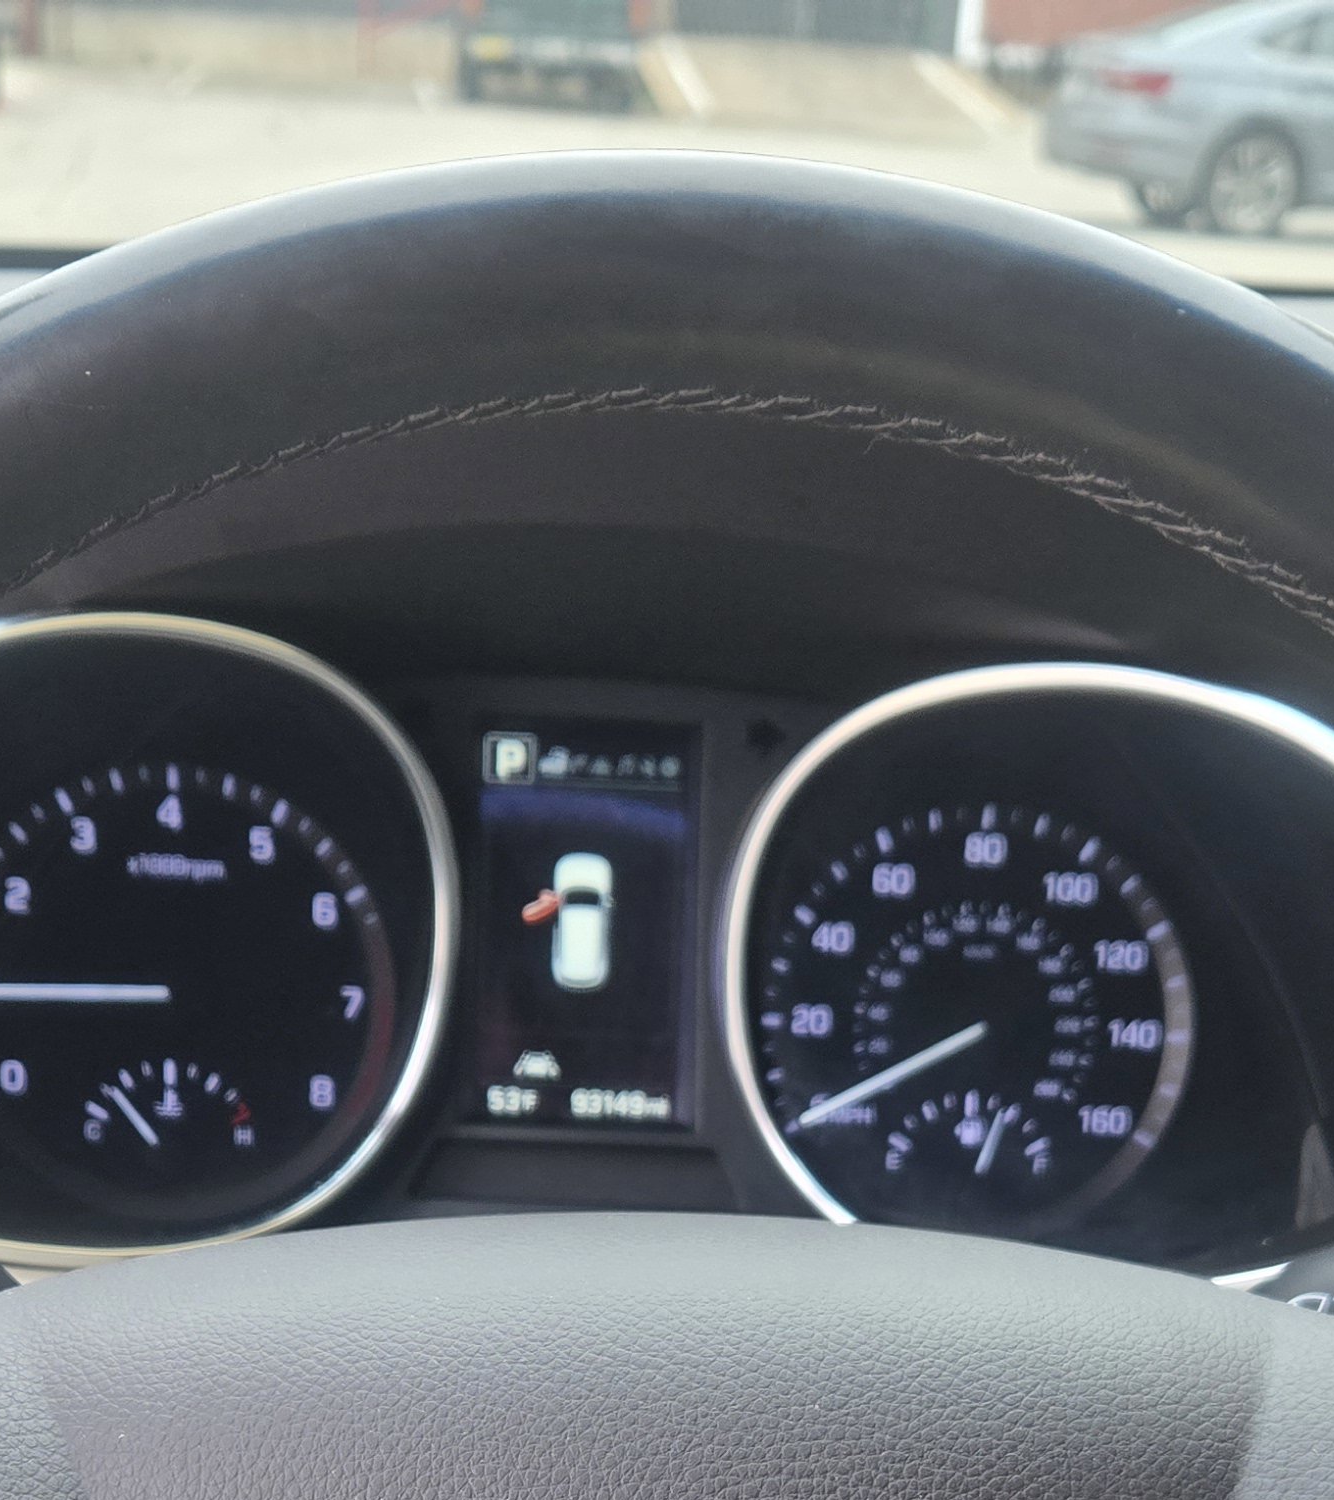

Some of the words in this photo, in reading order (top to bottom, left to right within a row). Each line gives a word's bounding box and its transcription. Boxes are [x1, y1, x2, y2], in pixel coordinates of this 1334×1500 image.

[496, 739, 526, 782] P
[156, 794, 184, 831] 4
[69, 816, 97, 855] 3
[249, 826, 275, 864] 5
[964, 832, 1008, 869] 80
[5, 876, 31, 914] 2
[872, 863, 915, 898] 60
[1042, 872, 1098, 907] 100
[311, 891, 337, 930] 6
[811, 920, 855, 956] 40
[1094, 939, 1150, 974] 120
[340, 985, 364, 1020] 7
[790, 1003, 833, 1038] 20
[1107, 1018, 1163, 1051] 140
[0, 1059, 28, 1096] 0
[309, 1074, 336, 1112] 8
[1078, 1105, 1133, 1138] 160
